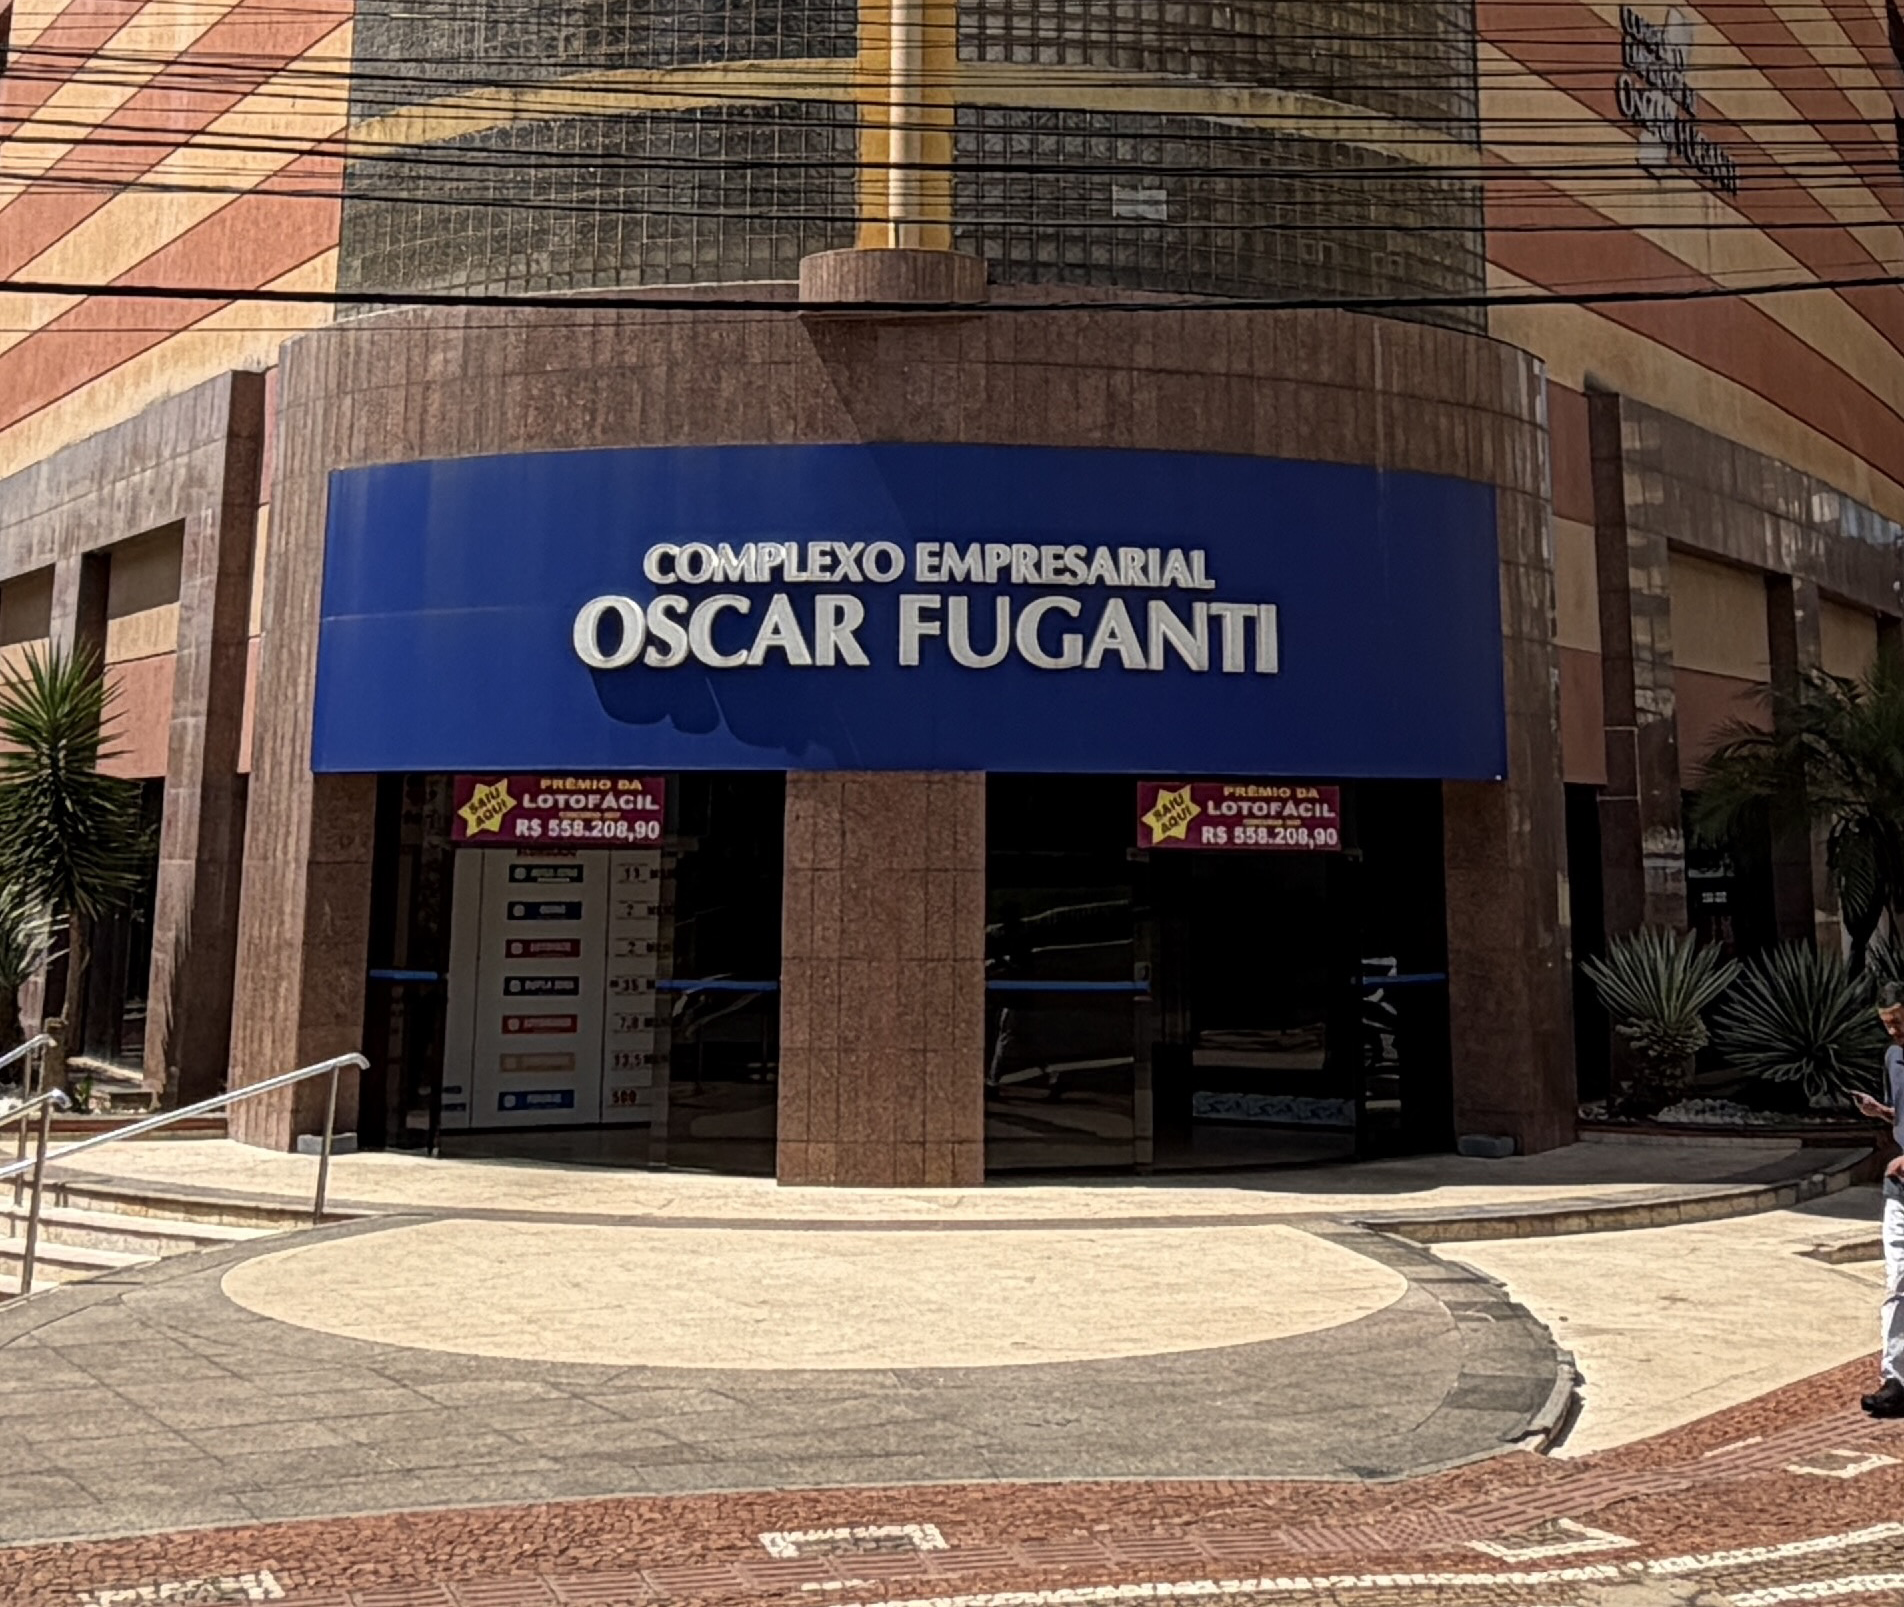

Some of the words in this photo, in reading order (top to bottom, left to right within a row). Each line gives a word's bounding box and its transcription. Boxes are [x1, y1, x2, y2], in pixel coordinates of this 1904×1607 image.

[643, 541, 905, 585] COMPLEXO
[914, 542, 1216, 589] EMPRESARIAL
[572, 593, 870, 669] OSCAR
[898, 593, 1280, 674] FUGANTI
[540, 777, 612, 790] PRÊMIO
[617, 779, 642, 790] DA
[1223, 785, 1291, 798] PRÊMIO
[1296, 787, 1319, 798] DA
[469, 787, 500, 816] SAIU
[475, 799, 508, 828] AQUI
[522, 791, 660, 810] LOTOFÁCIL
[1153, 792, 1184, 822] SAIU
[1207, 799, 1336, 818] LOTOFÁCIL
[515, 818, 542, 838] R$
[548, 819, 660, 842] 558.208,90
[1161, 805, 1192, 835] AQUI
[1201, 825, 1227, 845] R$
[1234, 827, 1338, 850] 558.208,90
